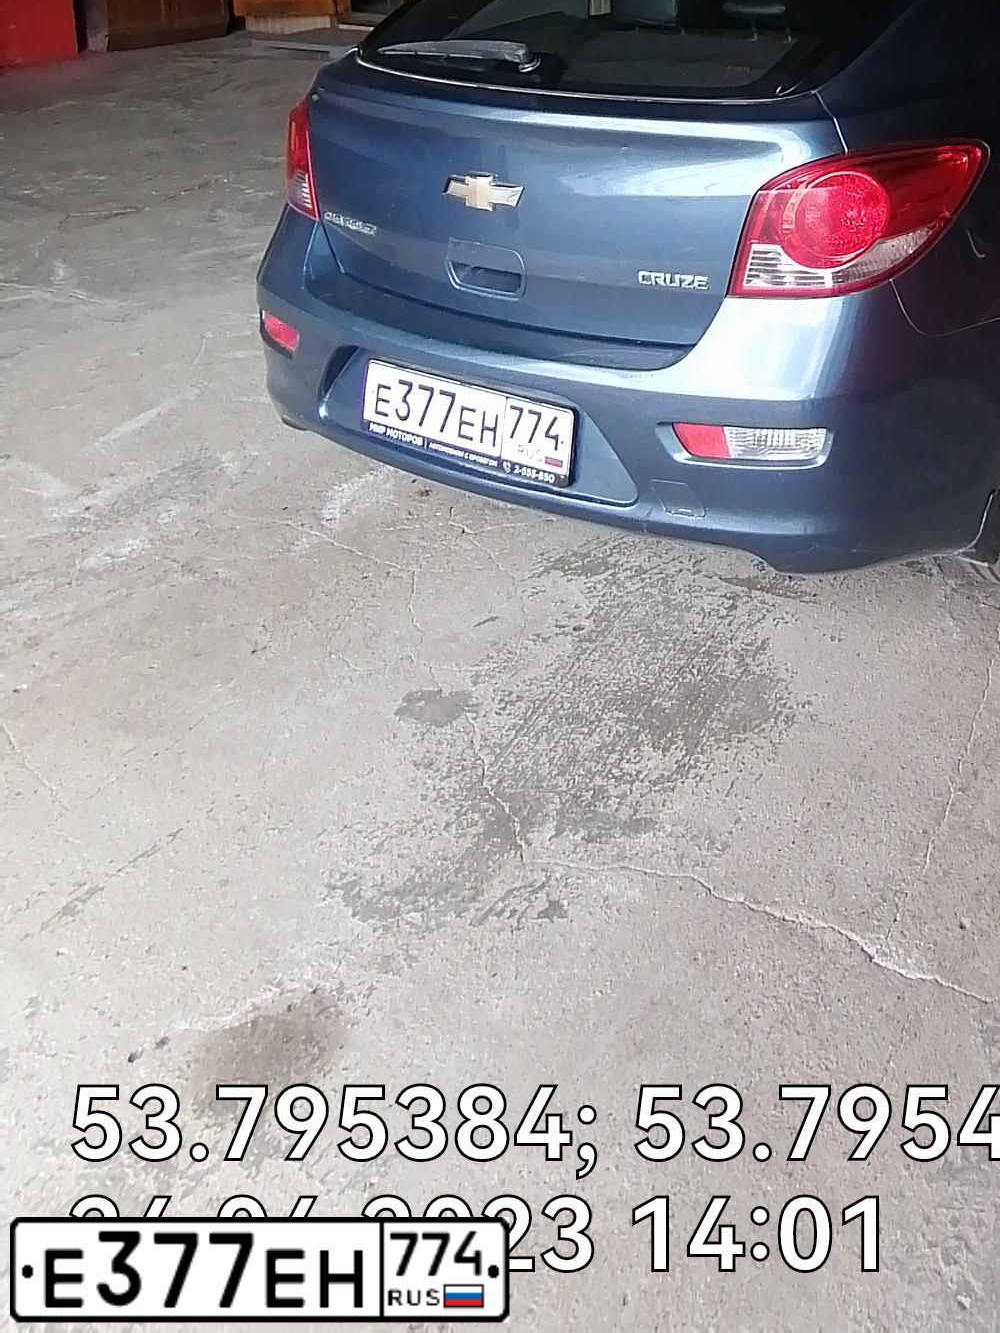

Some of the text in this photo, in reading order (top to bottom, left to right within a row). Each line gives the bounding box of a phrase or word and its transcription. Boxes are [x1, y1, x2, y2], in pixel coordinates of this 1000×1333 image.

[638, 270, 709, 290] CRUZE
[386, 426, 425, 447] МОТОРОВ
[509, 404, 560, 452] 774
